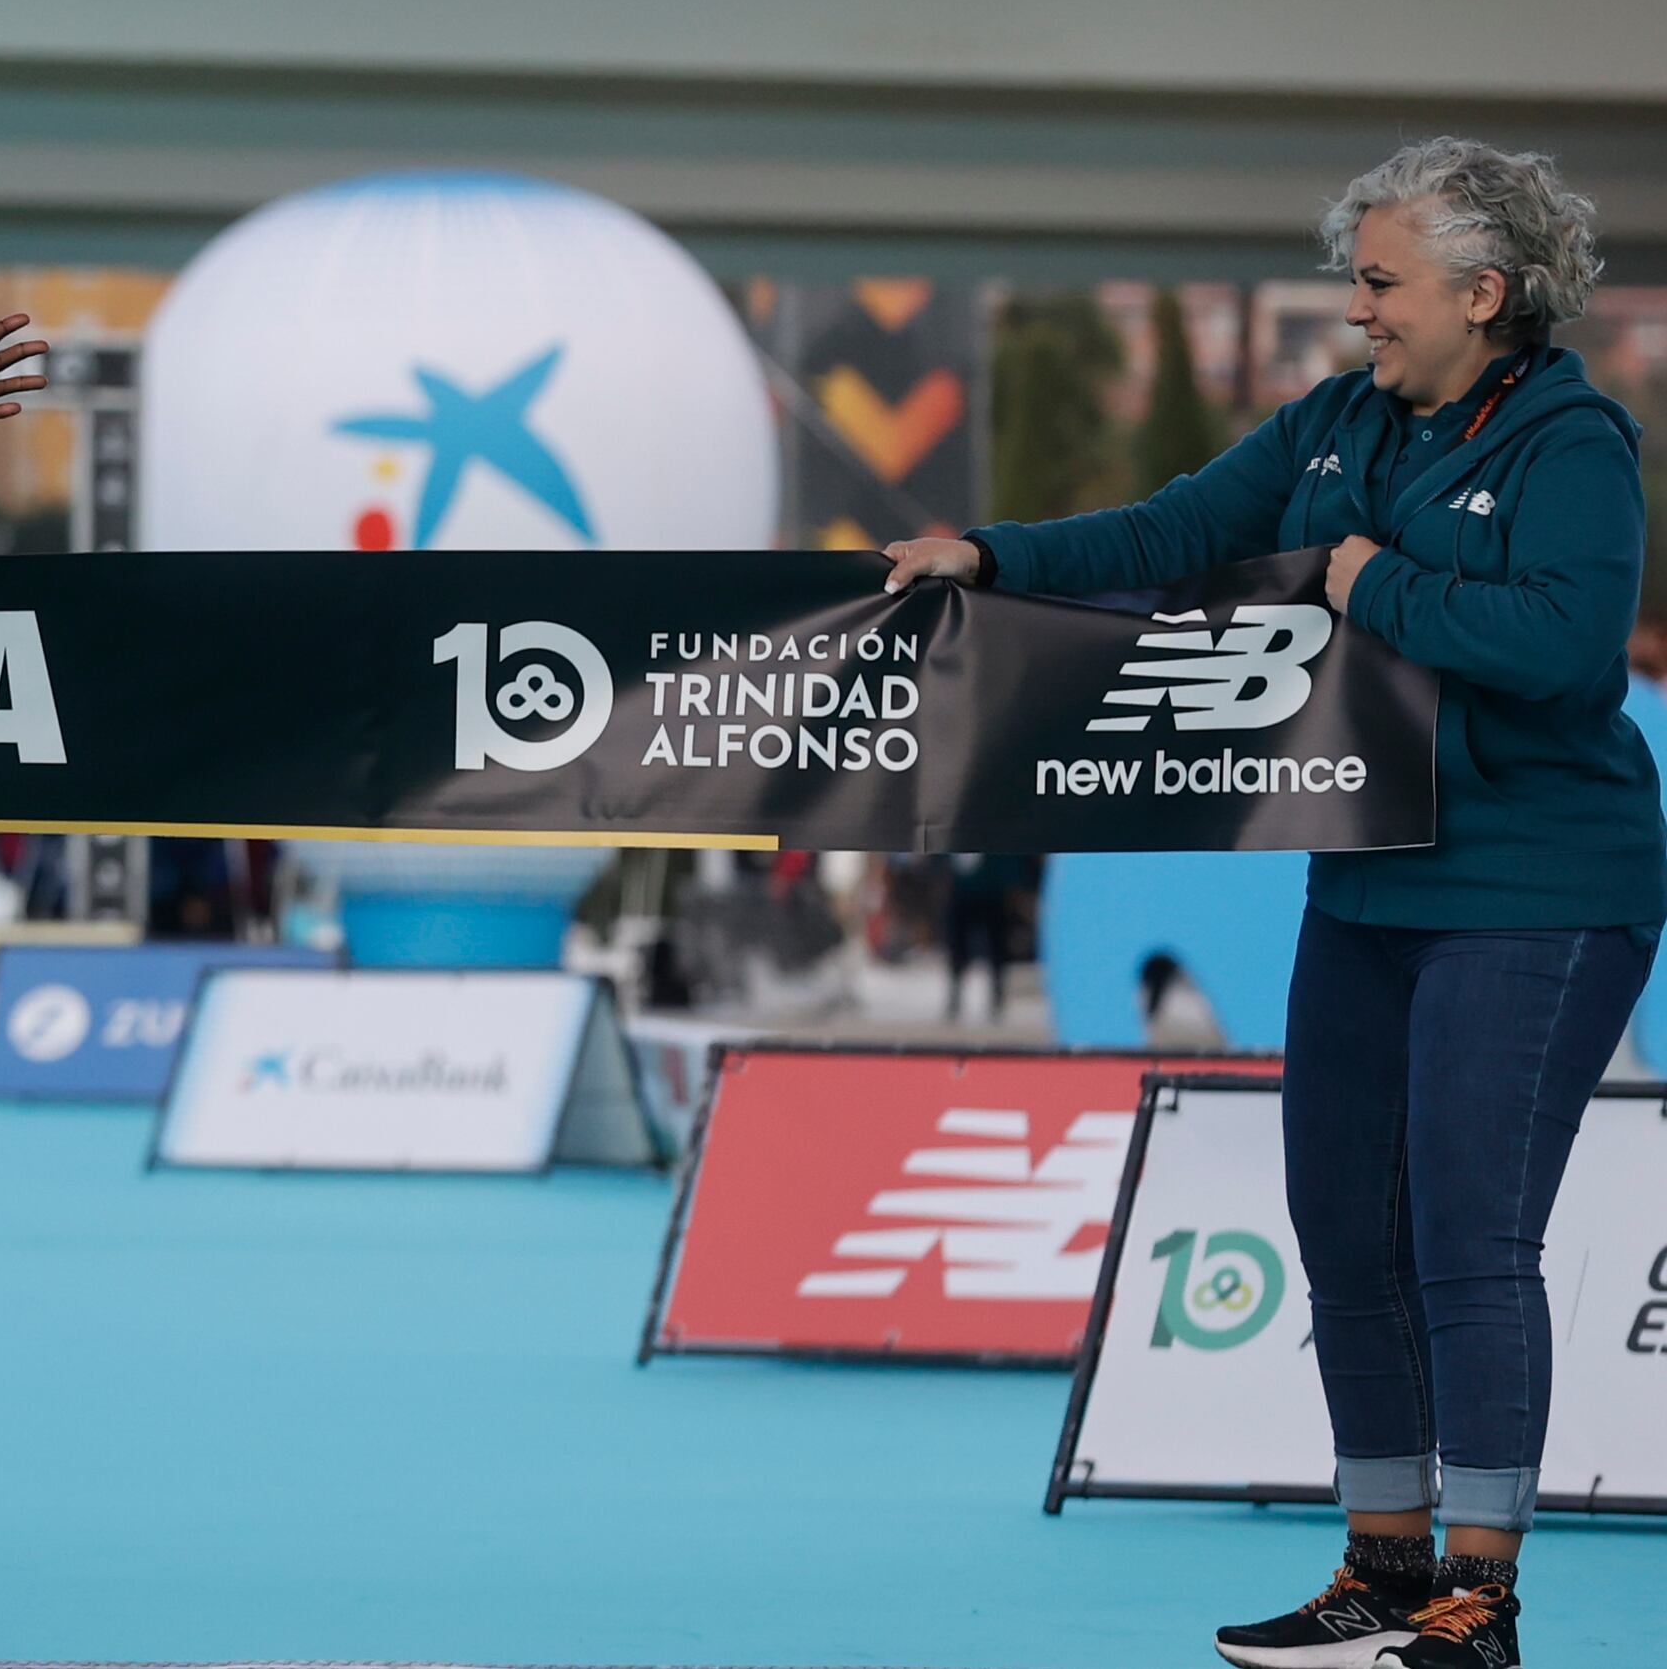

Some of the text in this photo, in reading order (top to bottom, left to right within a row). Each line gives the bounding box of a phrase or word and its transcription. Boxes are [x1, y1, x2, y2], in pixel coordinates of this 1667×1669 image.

[650, 627, 918, 663] FUNDACIÓN
[645, 672, 919, 720] TRINIDAD
[641, 723, 919, 772] ALFONSO
[1036, 747, 1367, 796] new balance
